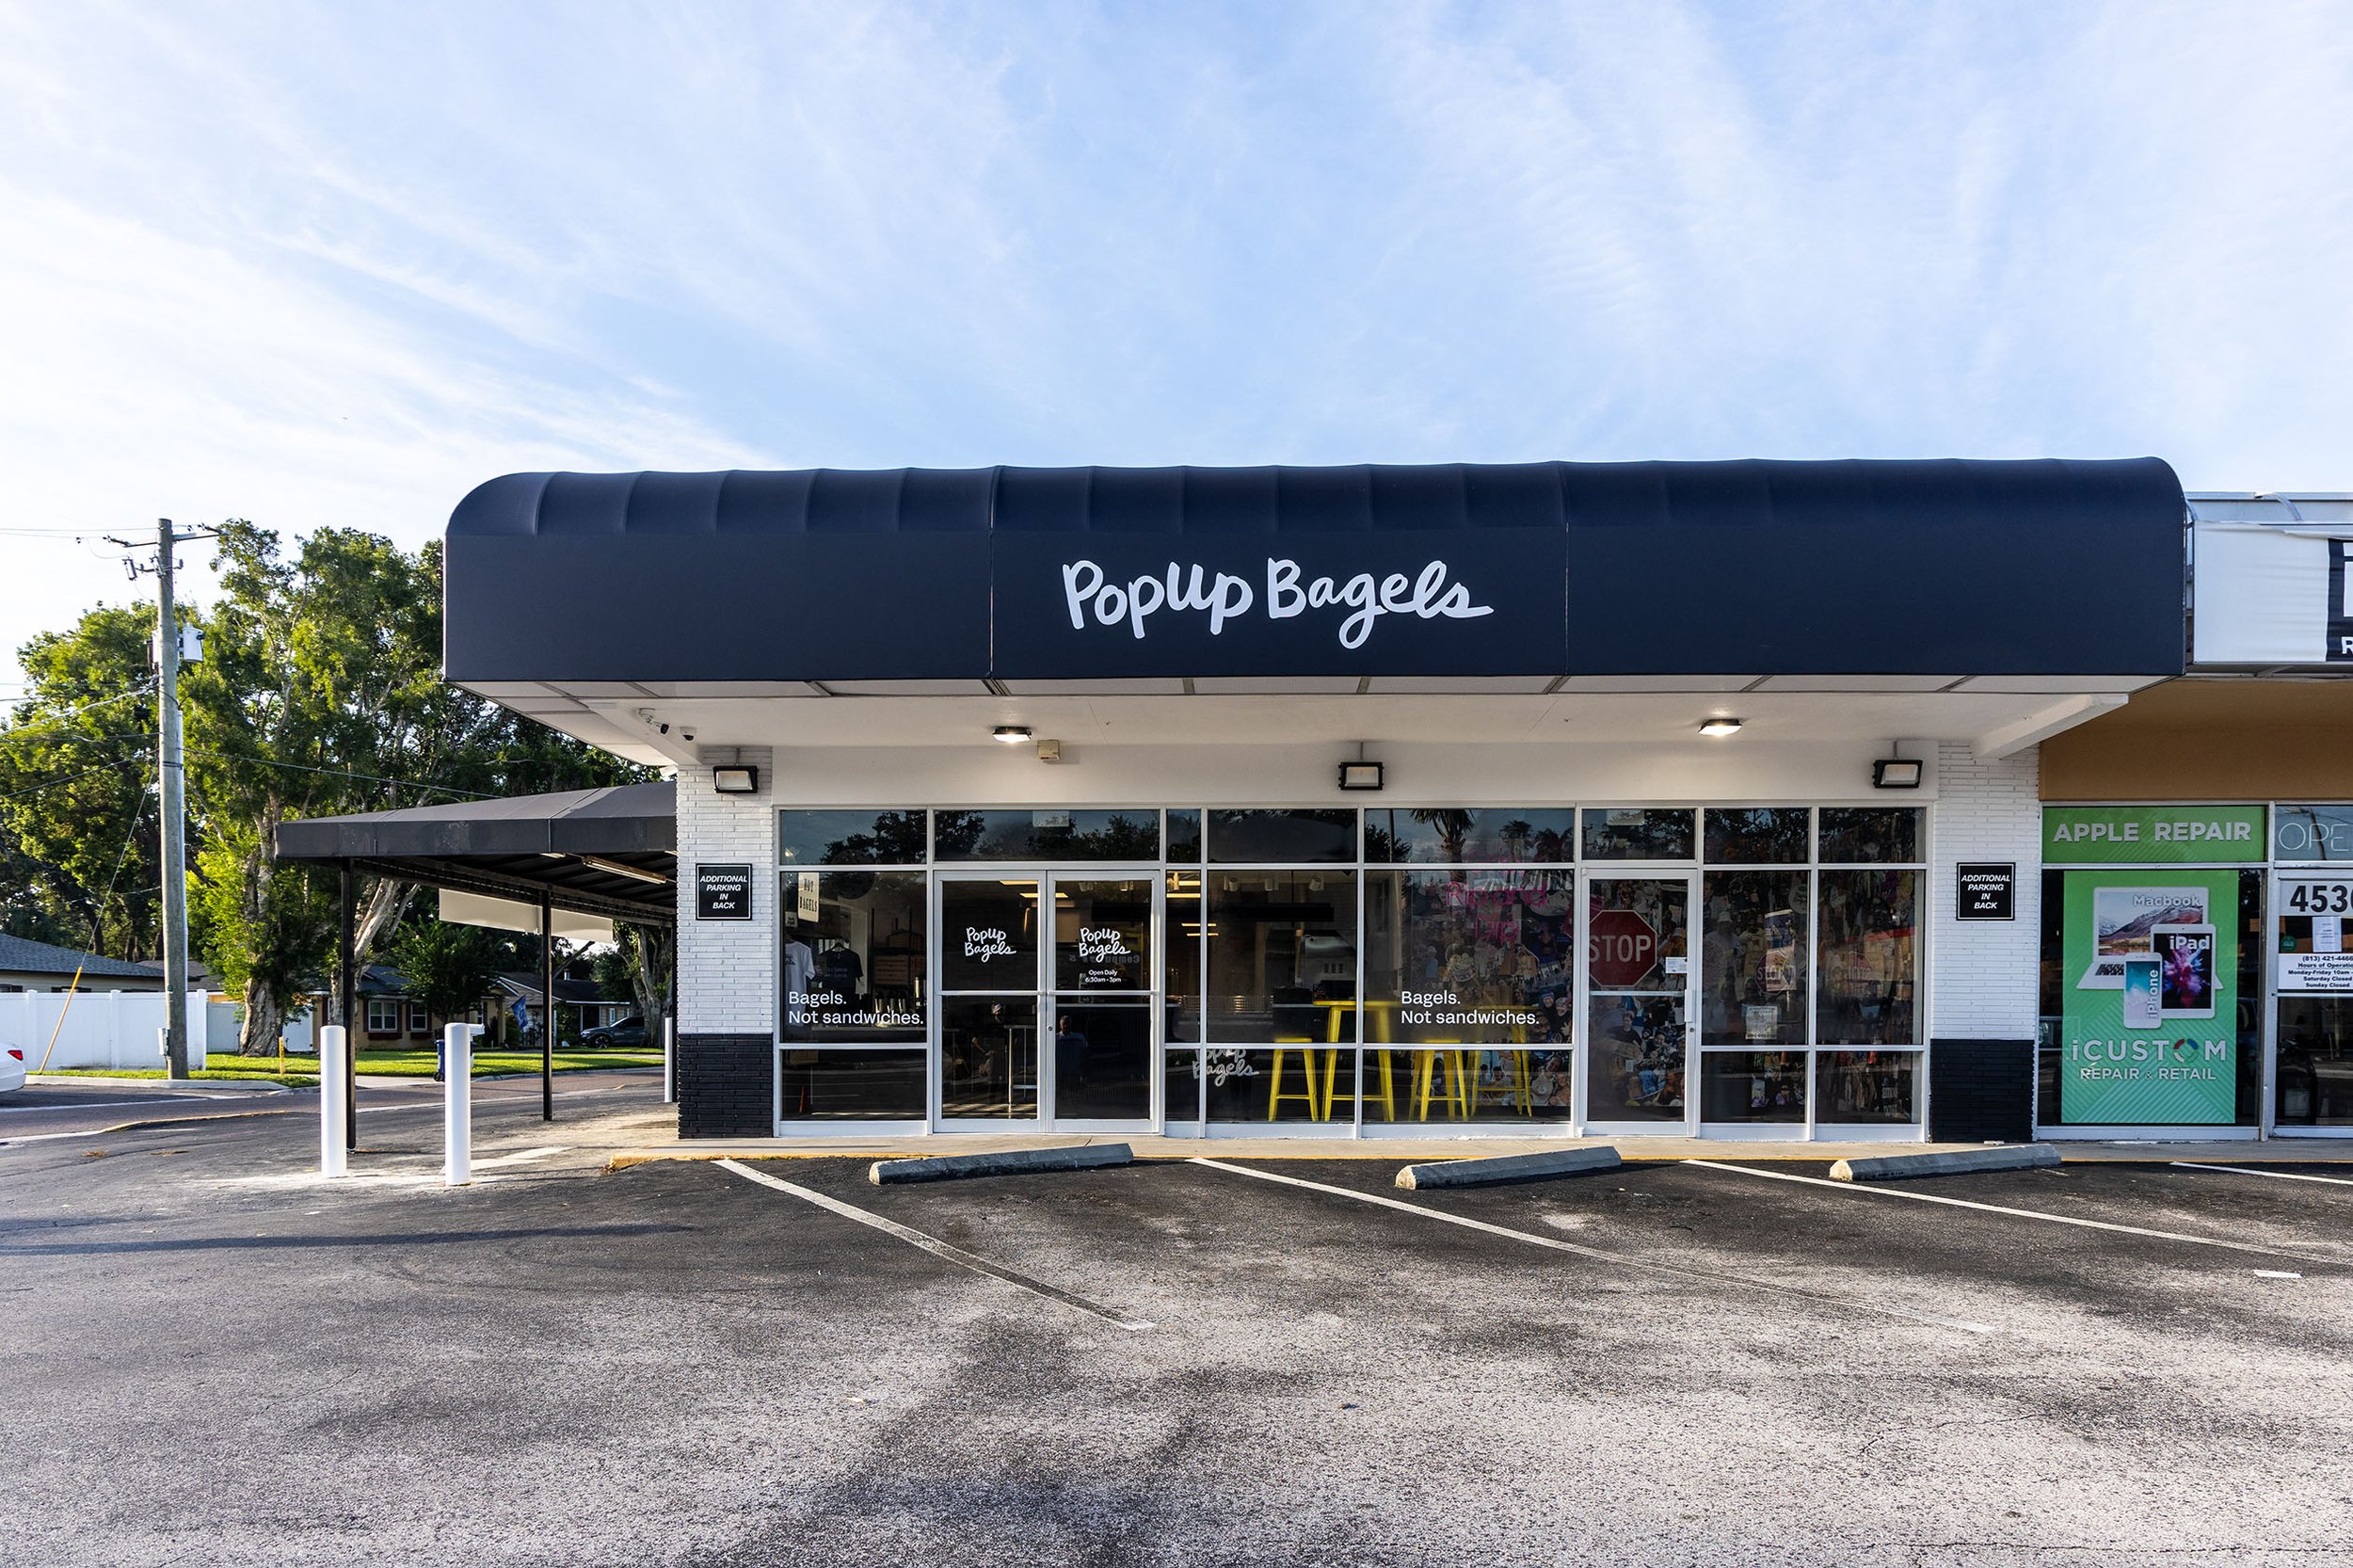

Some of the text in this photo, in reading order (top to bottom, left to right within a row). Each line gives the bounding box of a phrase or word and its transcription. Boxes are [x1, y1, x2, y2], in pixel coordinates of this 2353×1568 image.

[1062, 557, 1495, 649] PopUp Bagels
[2053, 822, 2251, 842] APPLE REPAIR
[2133, 895, 2201, 907] Macbook
[2290, 885, 2353, 912] 453
[965, 941, 1016, 963] Bagels
[1079, 941, 1130, 963] Bagels
[1589, 935, 1652, 963] STOP
[2169, 936, 2211, 950] iPad
[789, 990, 846, 1007] Bagels.
[1401, 990, 1461, 1007] Bagels.
[2147, 969, 2158, 1018] iPhone
[789, 1010, 923, 1024] Not sandwiches.
[1401, 1010, 1540, 1024] Not sandwiches.
[2080, 1068, 2217, 1080] REPAIR & RETAIL
